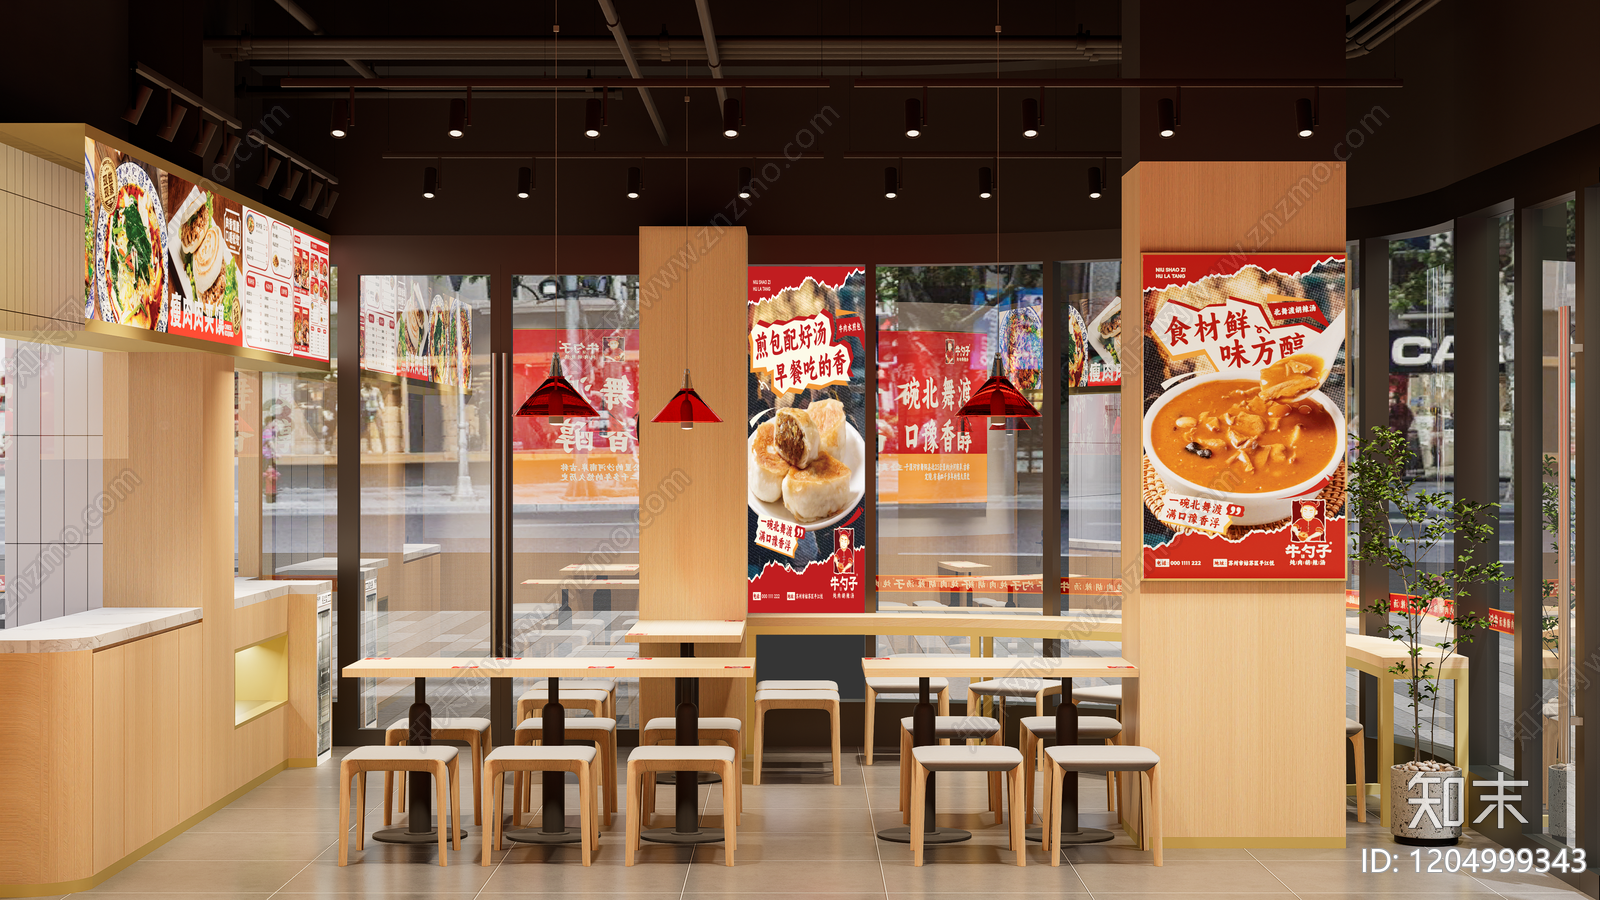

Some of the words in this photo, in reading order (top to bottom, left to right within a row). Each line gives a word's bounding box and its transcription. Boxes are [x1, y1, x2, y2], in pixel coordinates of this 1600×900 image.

[755, 321, 826, 360] 煎包配好汤
[1164, 309, 1250, 346] 食材鲜
[1219, 332, 1306, 368] 味方醇
[775, 349, 846, 388] 早餐吃的香
[1166, 509, 1220, 528] 满口豫香浮
[1169, 498, 1222, 516] 一碗北舞渡
[1285, 544, 1332, 558] 牛勺子
[830, 576, 858, 591] 牛勺子
